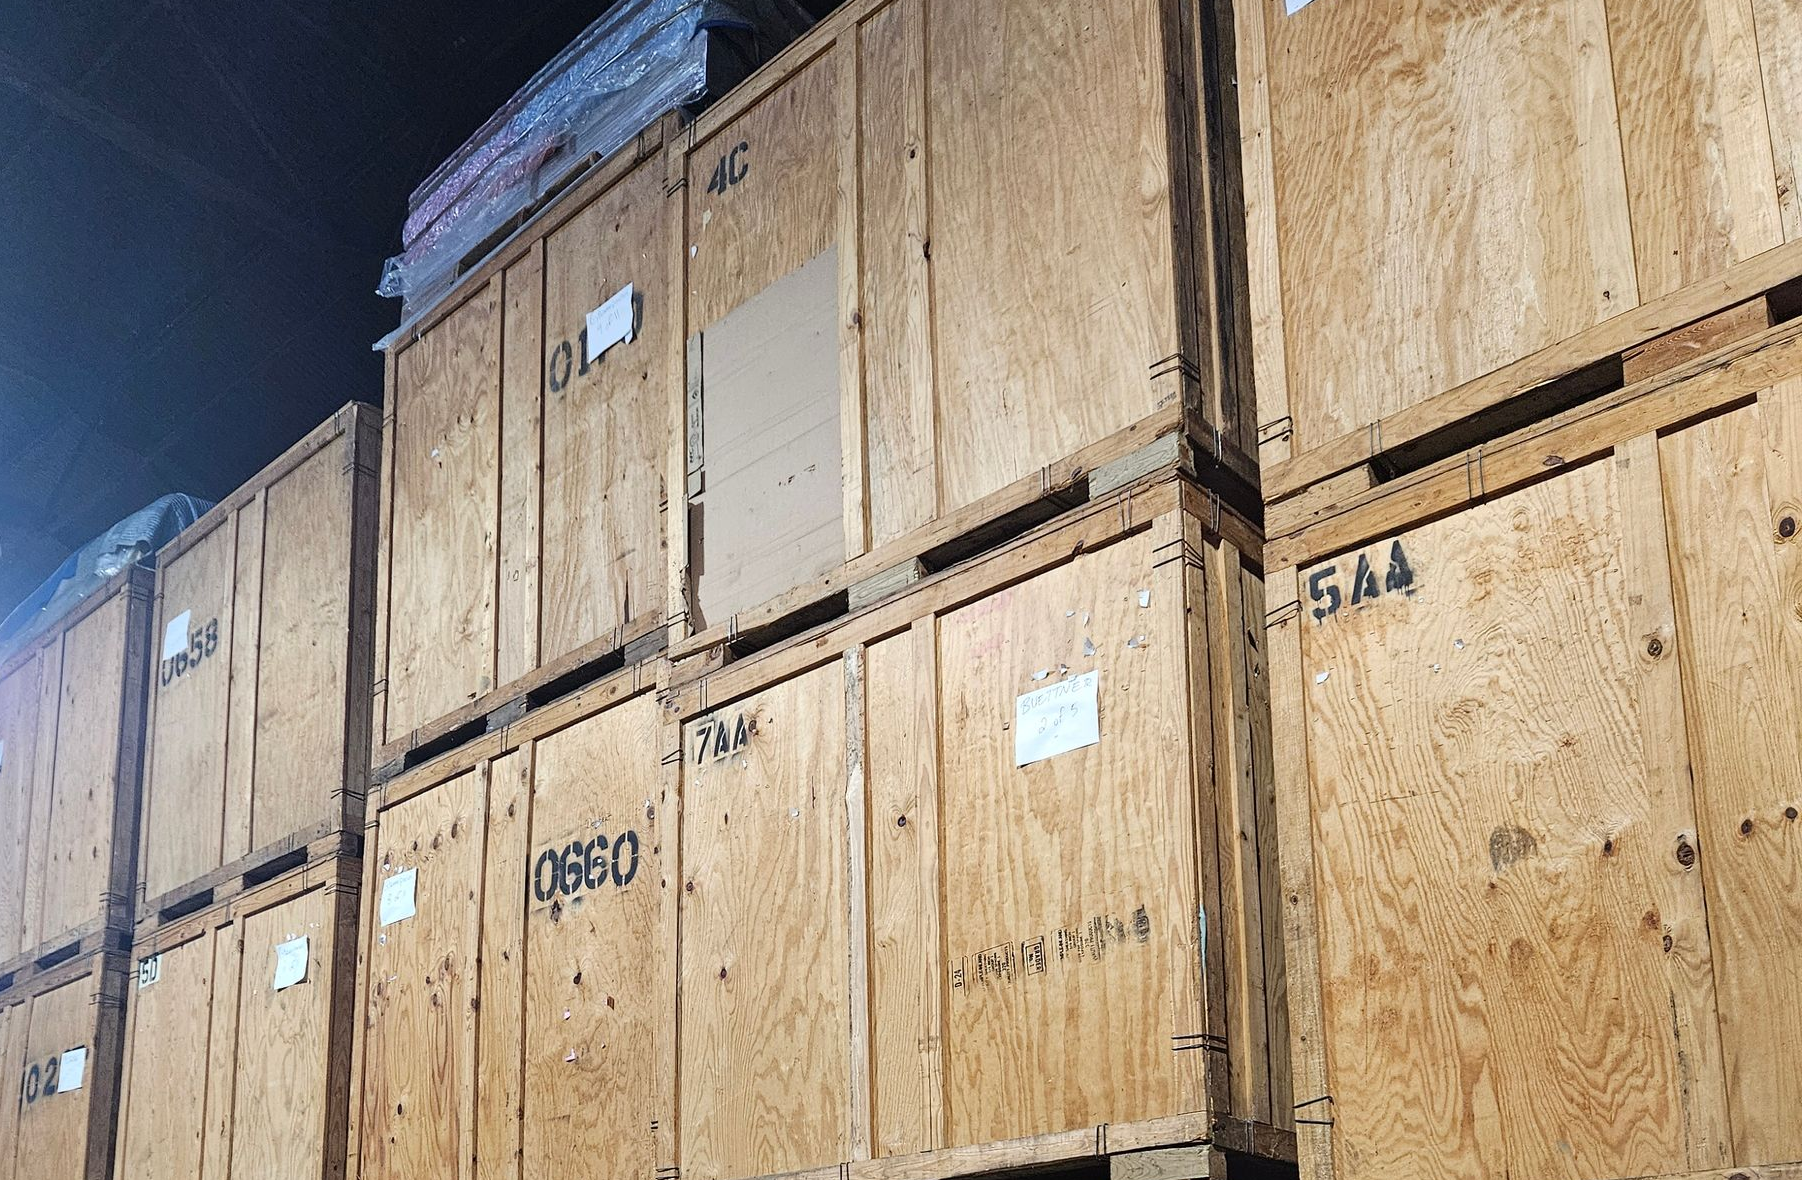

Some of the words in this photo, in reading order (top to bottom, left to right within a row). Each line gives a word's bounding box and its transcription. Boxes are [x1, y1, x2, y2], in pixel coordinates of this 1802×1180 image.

[707, 141, 748, 195] 4C
[549, 291, 644, 393] 01
[1309, 540, 1413, 620] 5AA
[1021, 675, 1092, 716] BUETTNER
[1038, 716, 1048, 735] 2
[1053, 705, 1065, 727] of
[1070, 701, 1079, 718] 5
[696, 713, 748, 765] 7AA
[534, 830, 639, 902] 0660
[1033, 945, 1042, 970] GRADER
